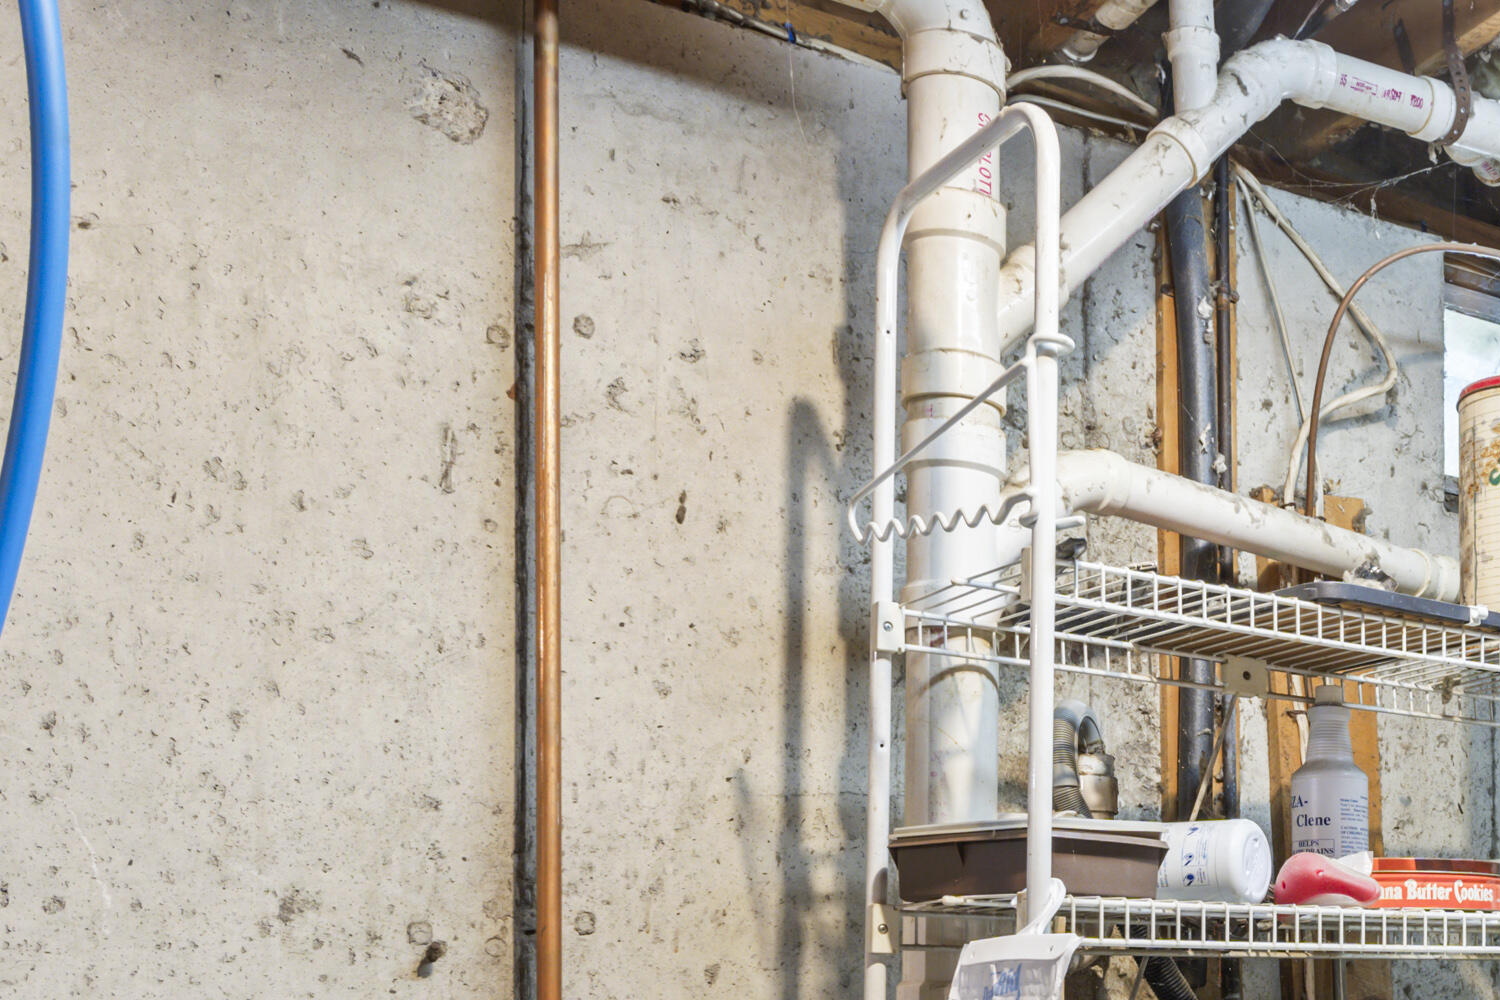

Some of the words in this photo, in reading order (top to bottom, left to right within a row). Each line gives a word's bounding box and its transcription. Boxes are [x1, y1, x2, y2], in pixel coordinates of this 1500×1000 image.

[1296, 813, 1331, 828] Clene
[1298, 839, 1320, 848] HELPS
[1404, 879, 1453, 900] Butter
[1454, 879, 1494, 904] Cookies
